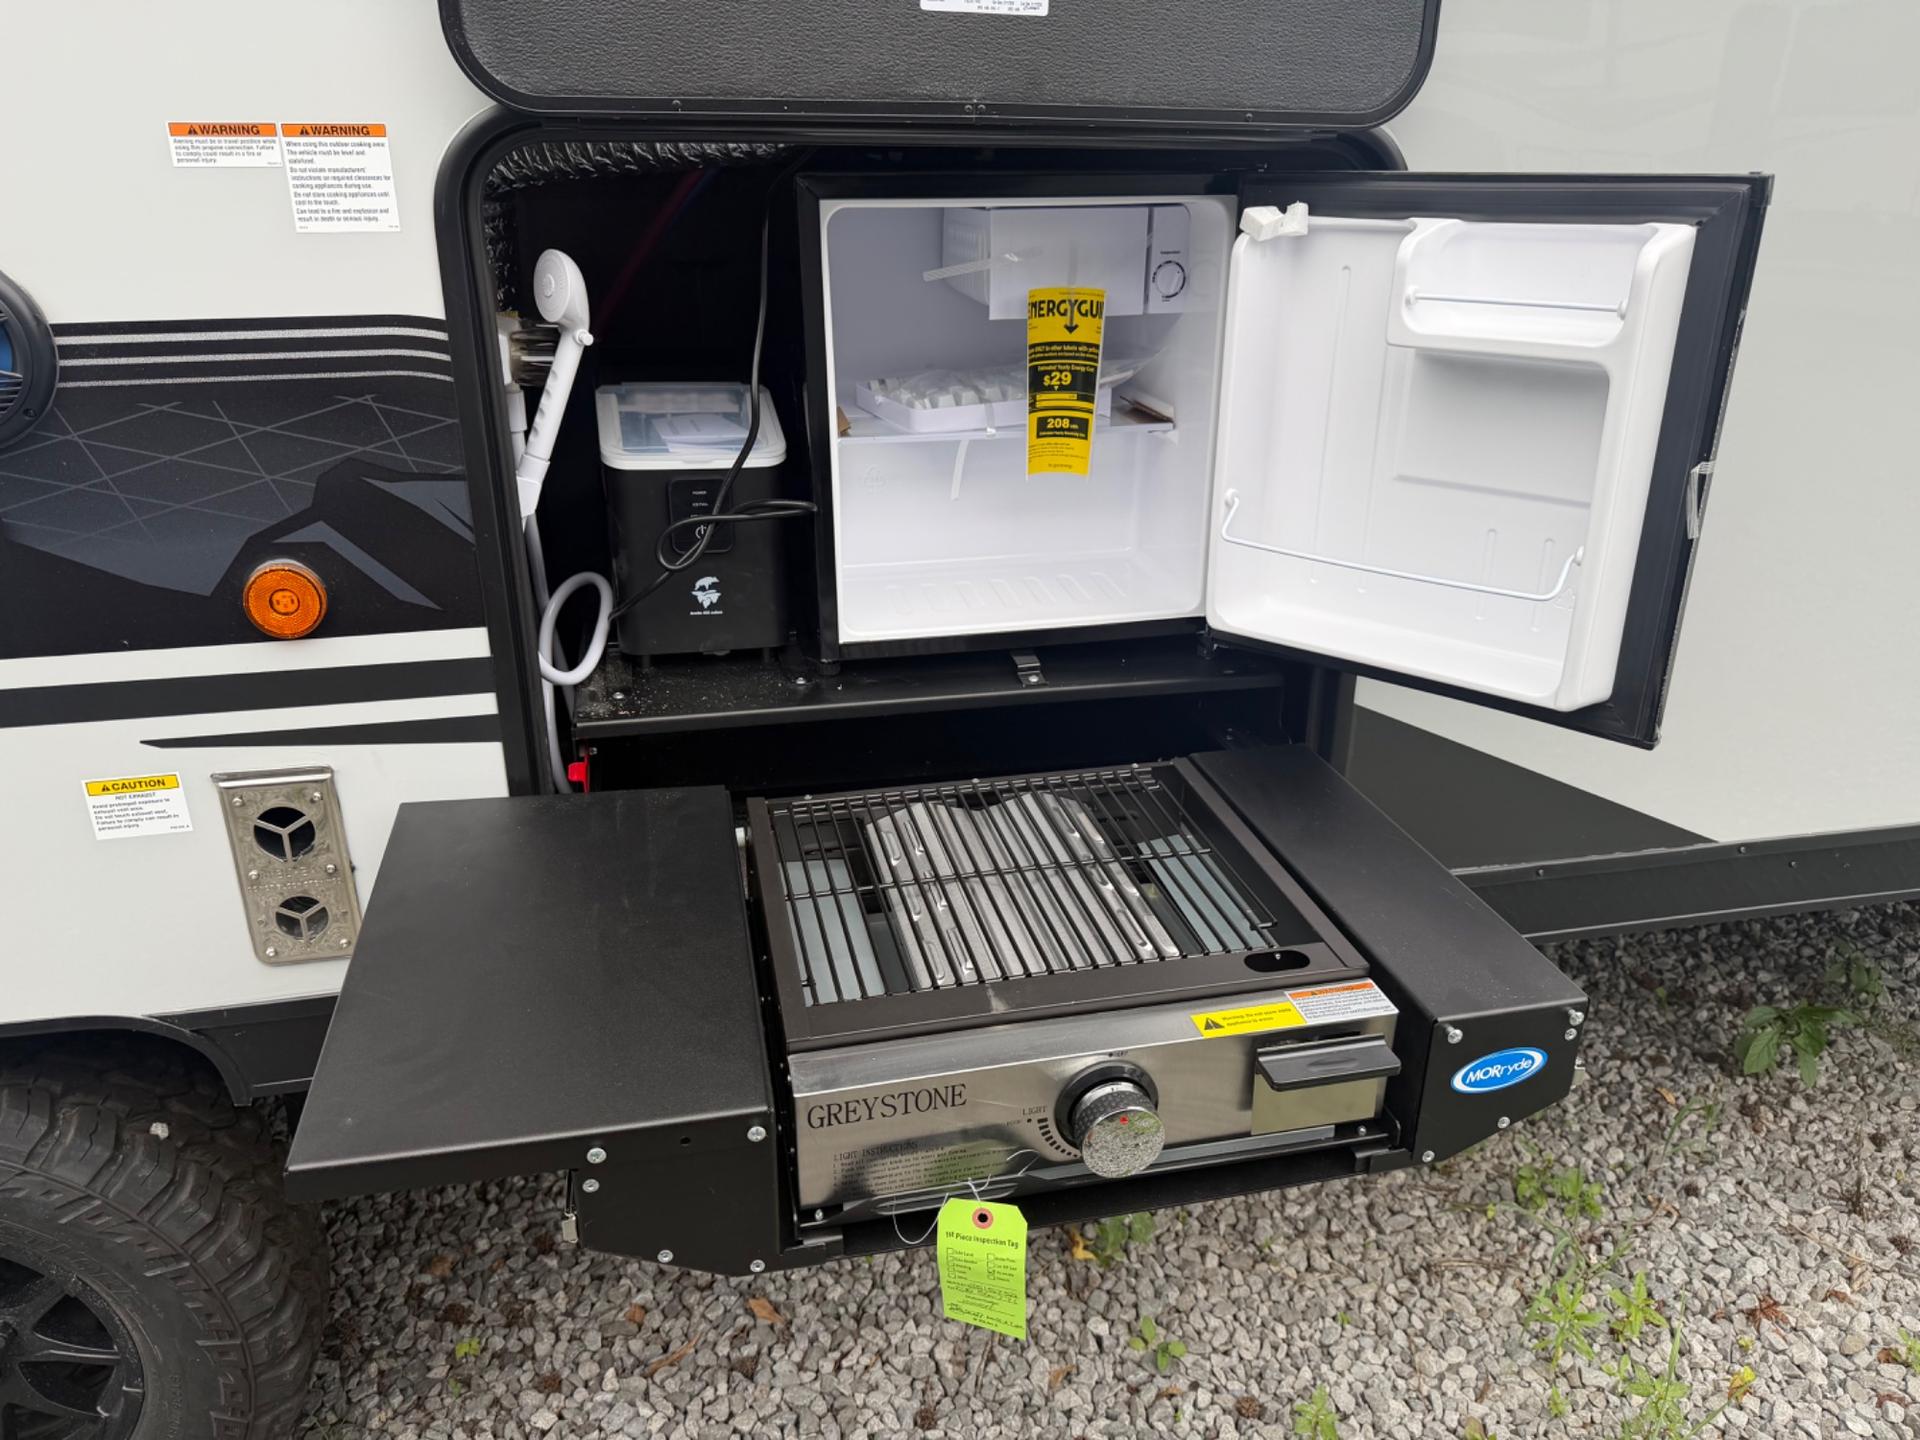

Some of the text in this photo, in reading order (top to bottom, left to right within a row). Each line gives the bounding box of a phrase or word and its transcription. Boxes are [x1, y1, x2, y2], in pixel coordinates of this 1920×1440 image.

[199, 124, 260, 135] WARNING
[310, 126, 370, 136] WARNING
[1028, 299, 1104, 319] NERGYGUI
[1043, 371, 1072, 386] $29
[1047, 418, 1070, 428] 208
[112, 779, 166, 792] CAUTION
[1465, 1058, 1533, 1084] MORryde
[807, 1083, 968, 1130] GREYSTONE
[956, 1232, 972, 1242] Piece
[974, 1236, 1006, 1246] Inspection
[1008, 1240, 1018, 1250] Tag
